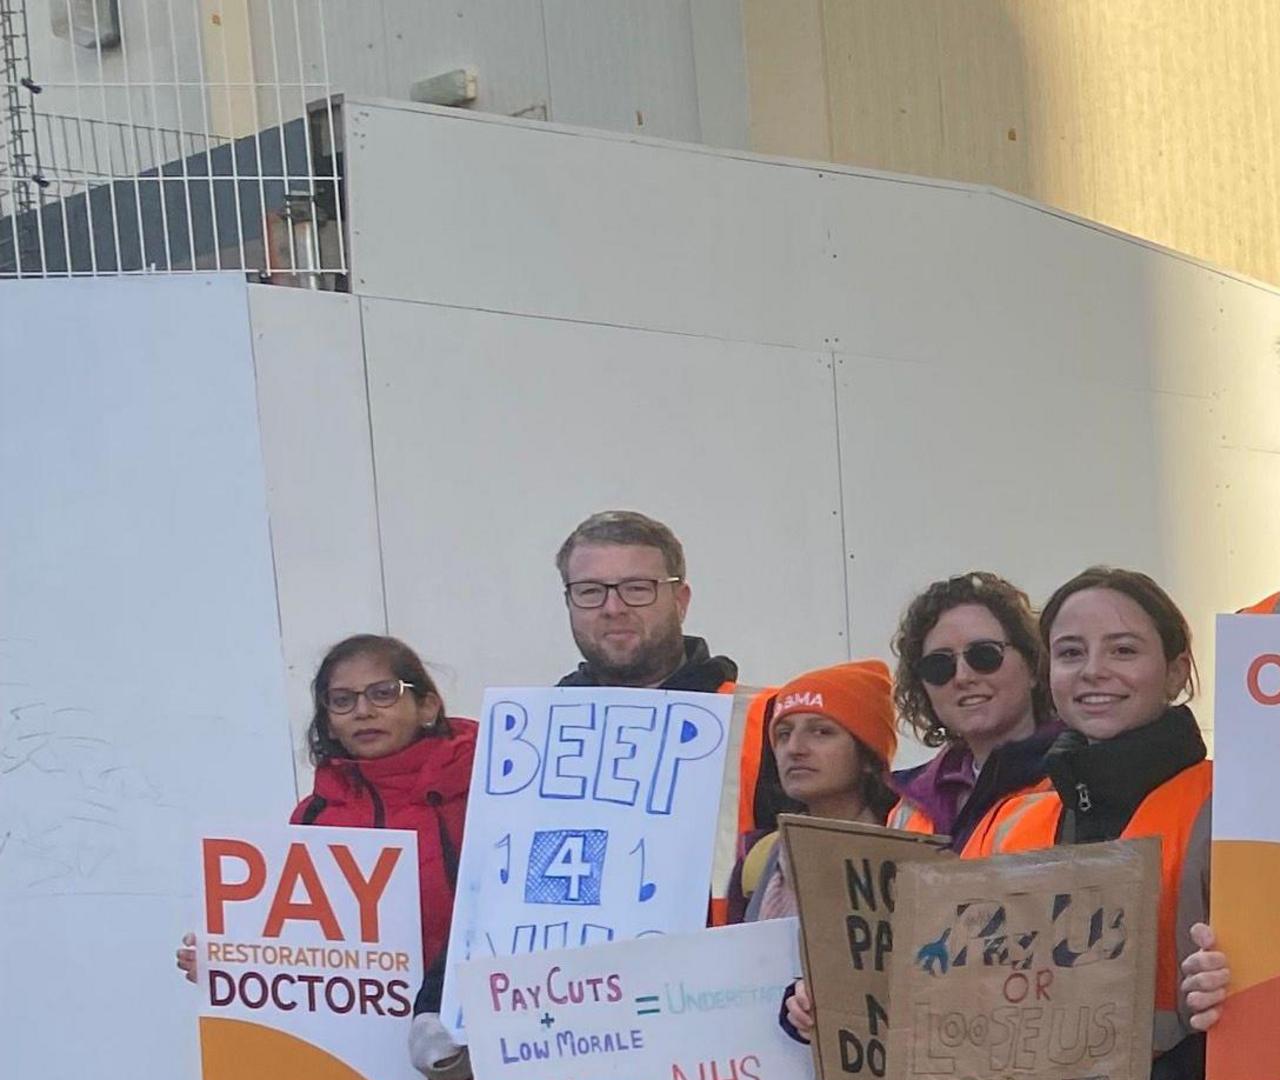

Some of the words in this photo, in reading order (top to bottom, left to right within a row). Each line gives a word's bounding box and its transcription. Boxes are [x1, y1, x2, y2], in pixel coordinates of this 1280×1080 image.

[485, 700, 724, 815] BEEP
[203, 838, 403, 943] PAY
[541, 834, 592, 901] 4
[207, 942, 360, 971] RESTORATION
[366, 951, 410, 972] FOR
[1003, 968, 1054, 1004] OR
[208, 970, 412, 1018] DOCTORS
[1049, 1001, 1117, 1067] US
